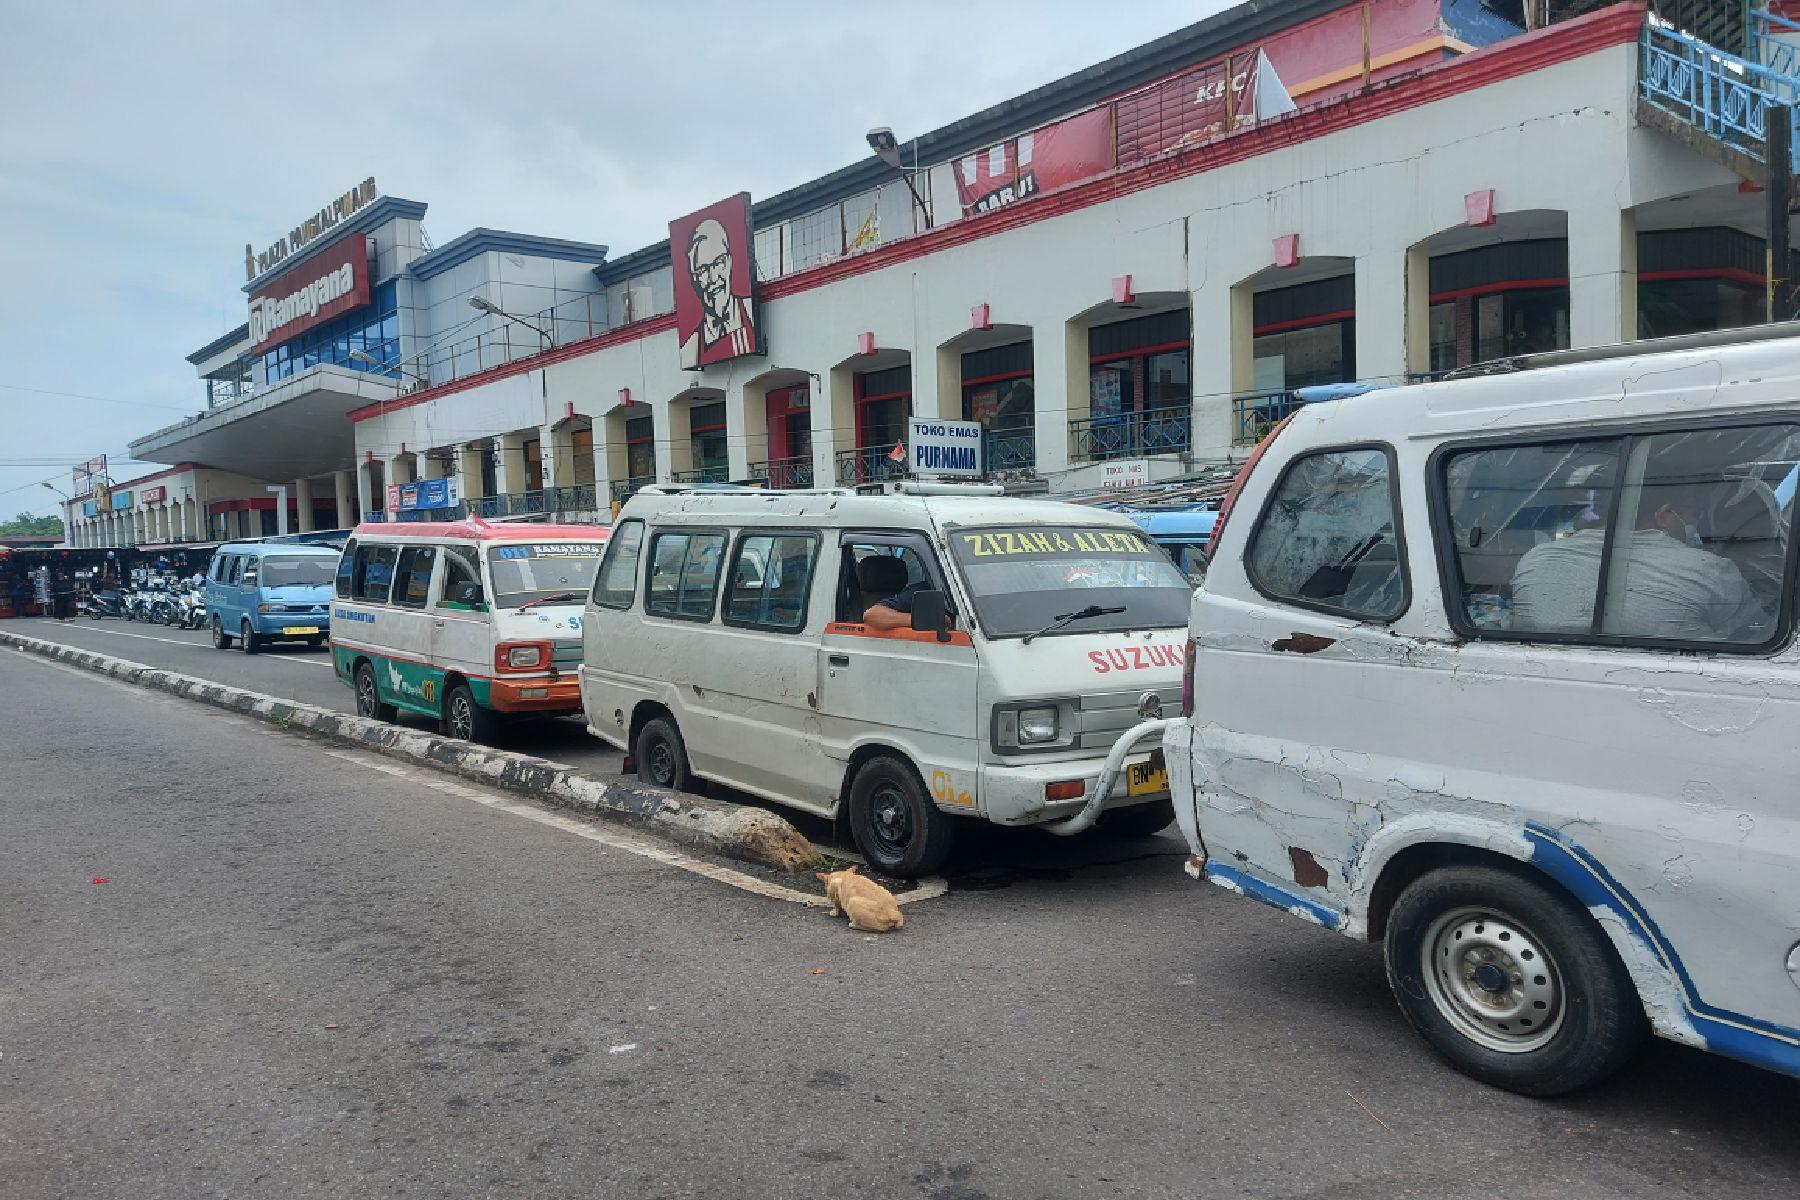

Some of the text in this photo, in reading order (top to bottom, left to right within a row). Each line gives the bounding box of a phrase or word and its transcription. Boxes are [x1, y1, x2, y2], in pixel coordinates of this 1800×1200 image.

[265, 262, 354, 333] Ramayana
[914, 424, 979, 438] TOKO EMAS
[916, 445, 977, 470] PURNAMA
[500, 546, 529, 560] 011
[963, 532, 1150, 556] ZIZAH & ALETA
